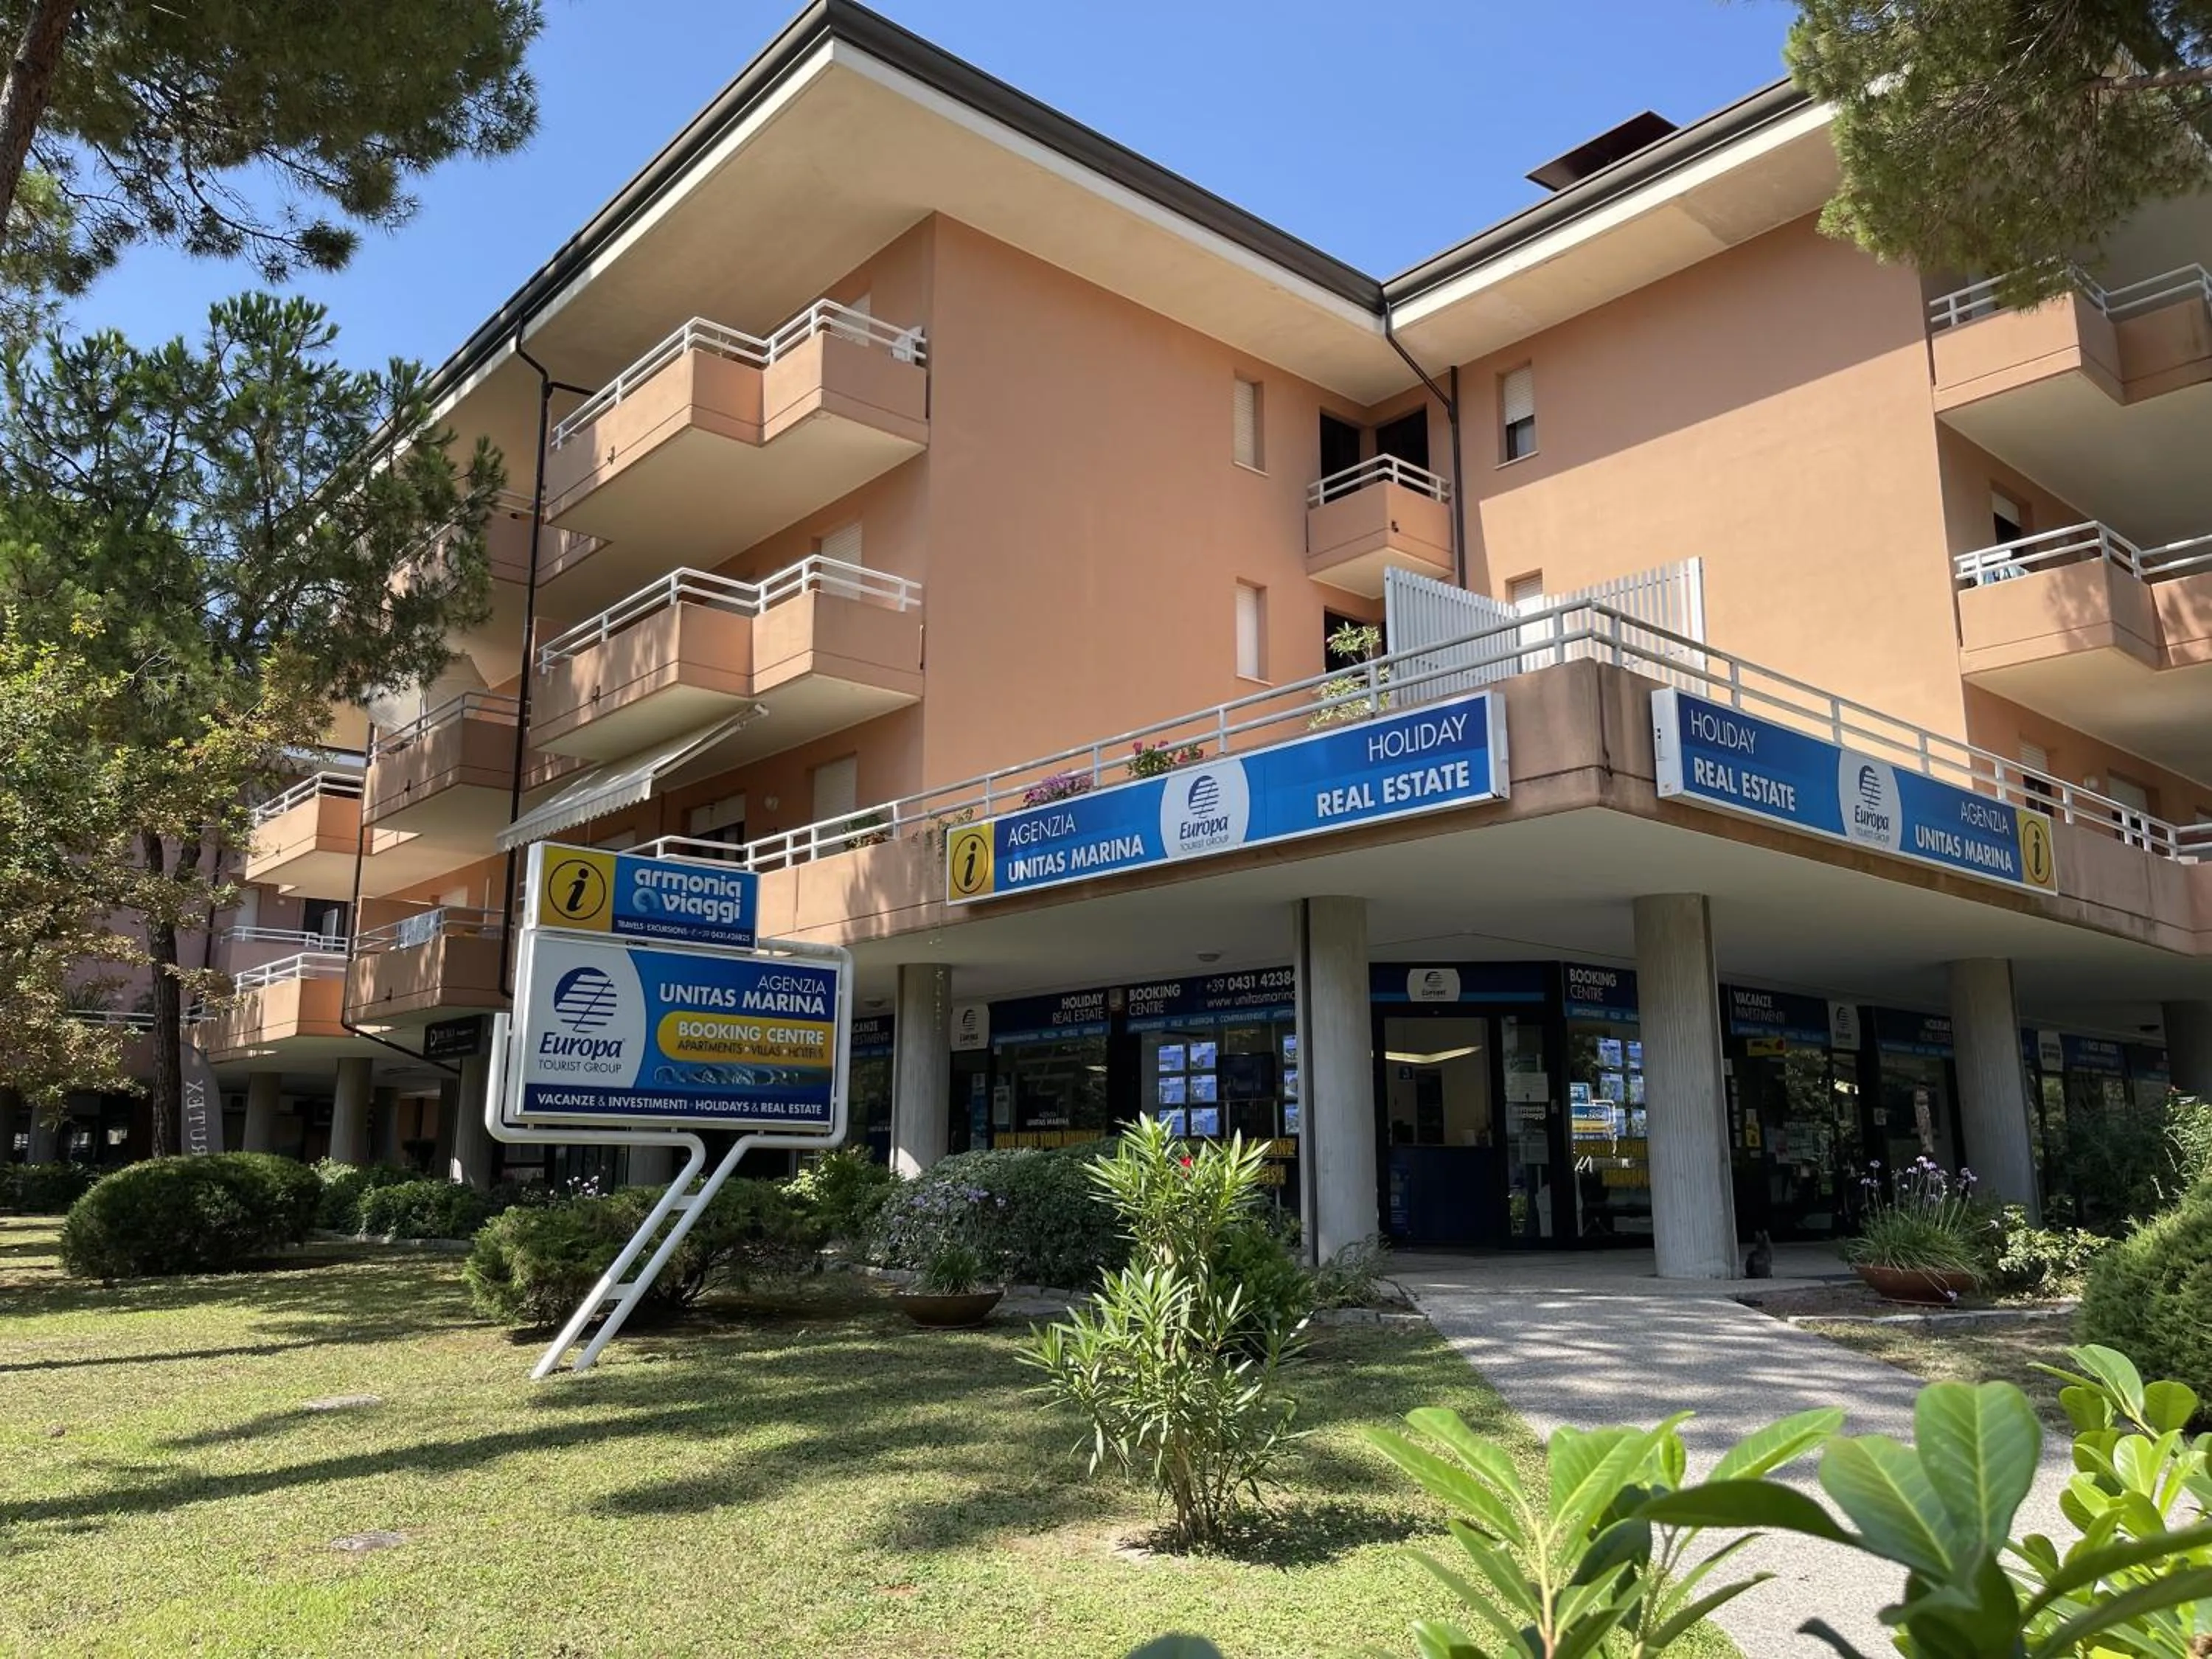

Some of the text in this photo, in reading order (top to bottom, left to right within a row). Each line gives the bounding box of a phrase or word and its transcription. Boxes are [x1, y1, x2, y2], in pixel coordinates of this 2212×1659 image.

[1368, 713, 1468, 762] HOLIDAY
[1690, 709, 1756, 755] HOLIDAY
[1317, 760, 1470, 818] REAL ESTATE
[1694, 757, 1795, 812] REAL ESTATE
[1008, 813, 1076, 847] AGENZIA
[1180, 816, 1228, 840] Europa
[1854, 804, 1889, 832] Europa
[1960, 801, 2010, 835] AGENZIA
[1007, 834, 1144, 883] UNITAS MARINA
[1915, 824, 2014, 873] UNITAS MARINA
[634, 868, 742, 899] armonia
[661, 891, 741, 924] viaggi
[757, 974, 827, 995] AGENZIA
[1206, 979, 1225, 994] +39
[1228, 975, 1256, 990] 0431
[1569, 967, 1616, 987] BOOKING
[659, 983, 825, 1015] UNITAS MARINA
[1061, 992, 1105, 1010] HOLIDAY
[1128, 984, 1180, 1003] BOOKING
[1570, 984, 1604, 1003] CENTRE
[1733, 990, 1773, 1008] VACANZE
[1052, 1006, 1105, 1026] REAL ESTATE
[1128, 1000, 1165, 1016] CENTRE
[678, 1020, 824, 1046] BOOKING CENTRE
[852, 1020, 878, 1034] CANZE
[539, 1032, 623, 1060] Europa
[677, 1040, 743, 1054] APARTMENTS
[751, 1044, 782, 1058] VILLAS
[539, 1059, 622, 1074] TOURIST GROUP
[538, 1093, 822, 1115] VACANZE & INVESTIMENTI HOLIDAYS & REAL ESTATE
